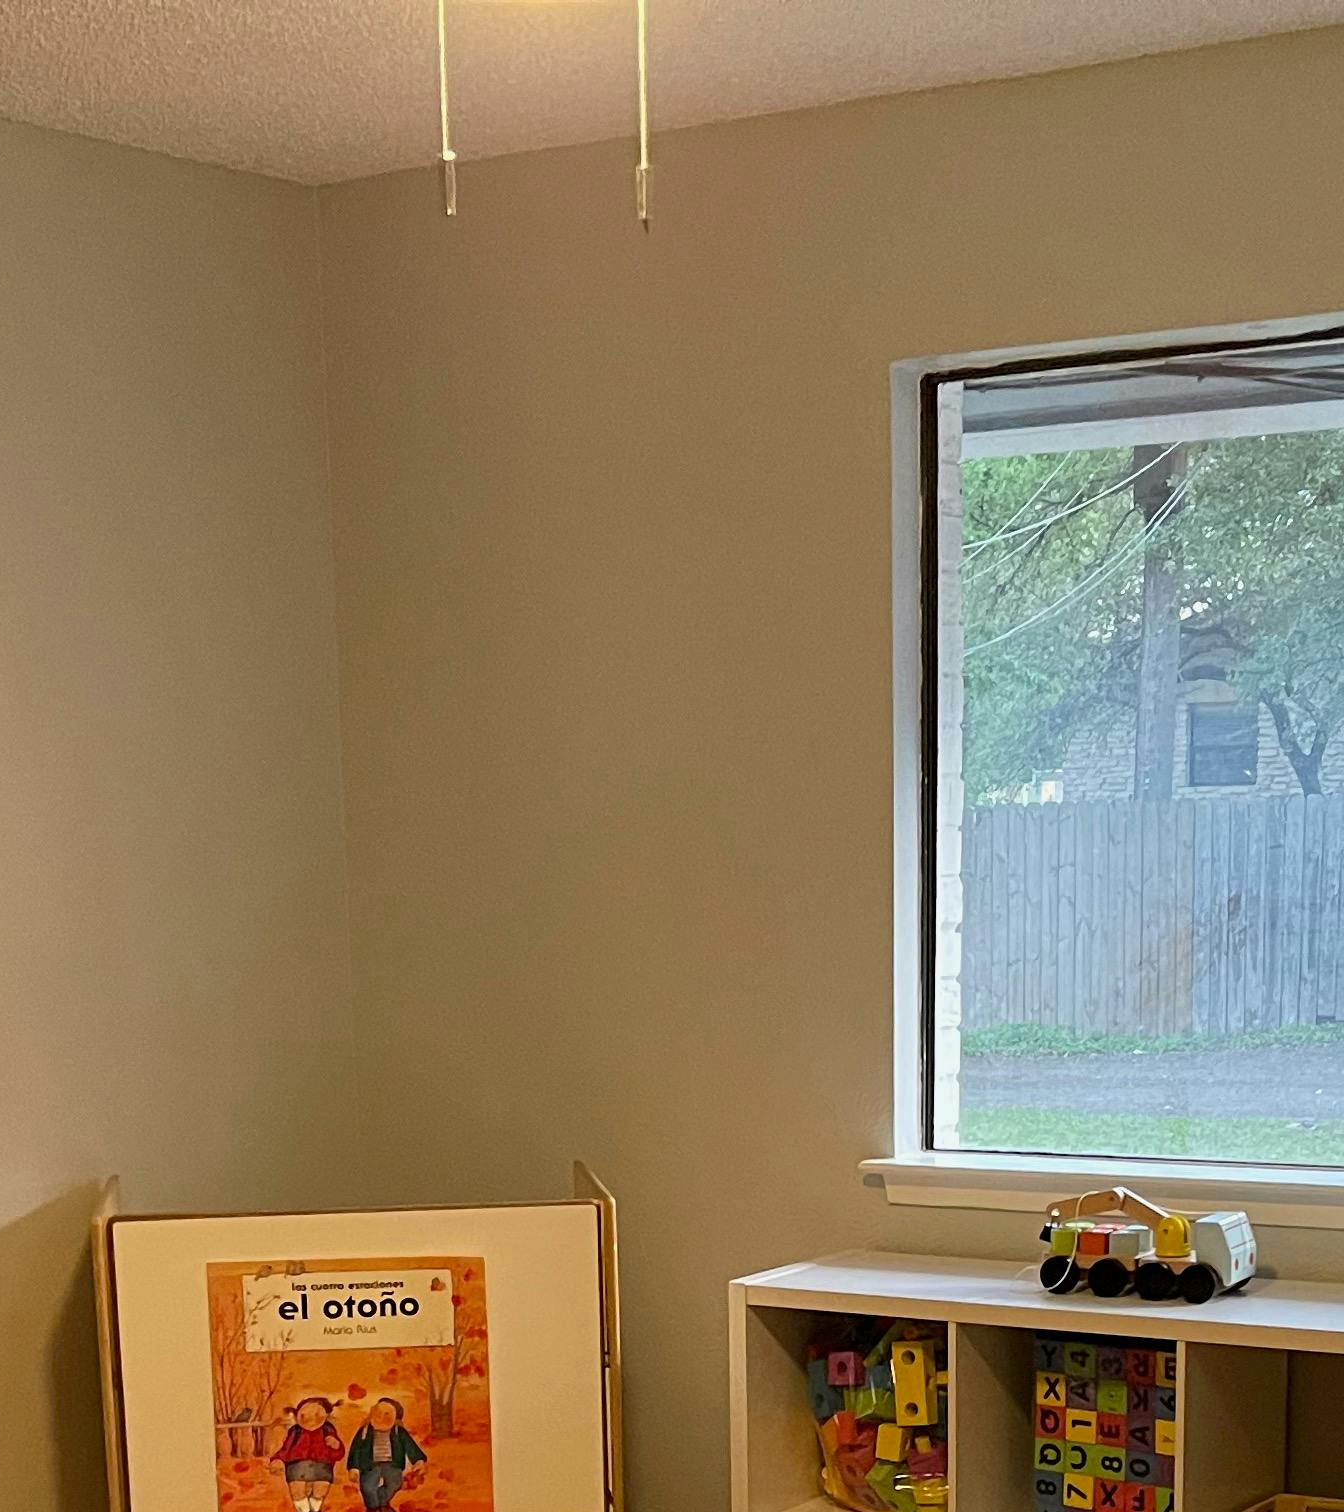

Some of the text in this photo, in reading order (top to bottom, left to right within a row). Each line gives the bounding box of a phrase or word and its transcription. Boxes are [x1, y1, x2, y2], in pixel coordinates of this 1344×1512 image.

[292, 1282, 306, 1291] las
[278, 1290, 420, 1320] el otoño
[1044, 1376, 1061, 1401] X
[1129, 1426, 1150, 1446] A
[1039, 1443, 1061, 1465] Q
[1101, 1456, 1122, 1473] 8
[1036, 1479, 1056, 1495] 8
[1067, 1483, 1087, 1499] 7
[1101, 1482, 1118, 1507] X
